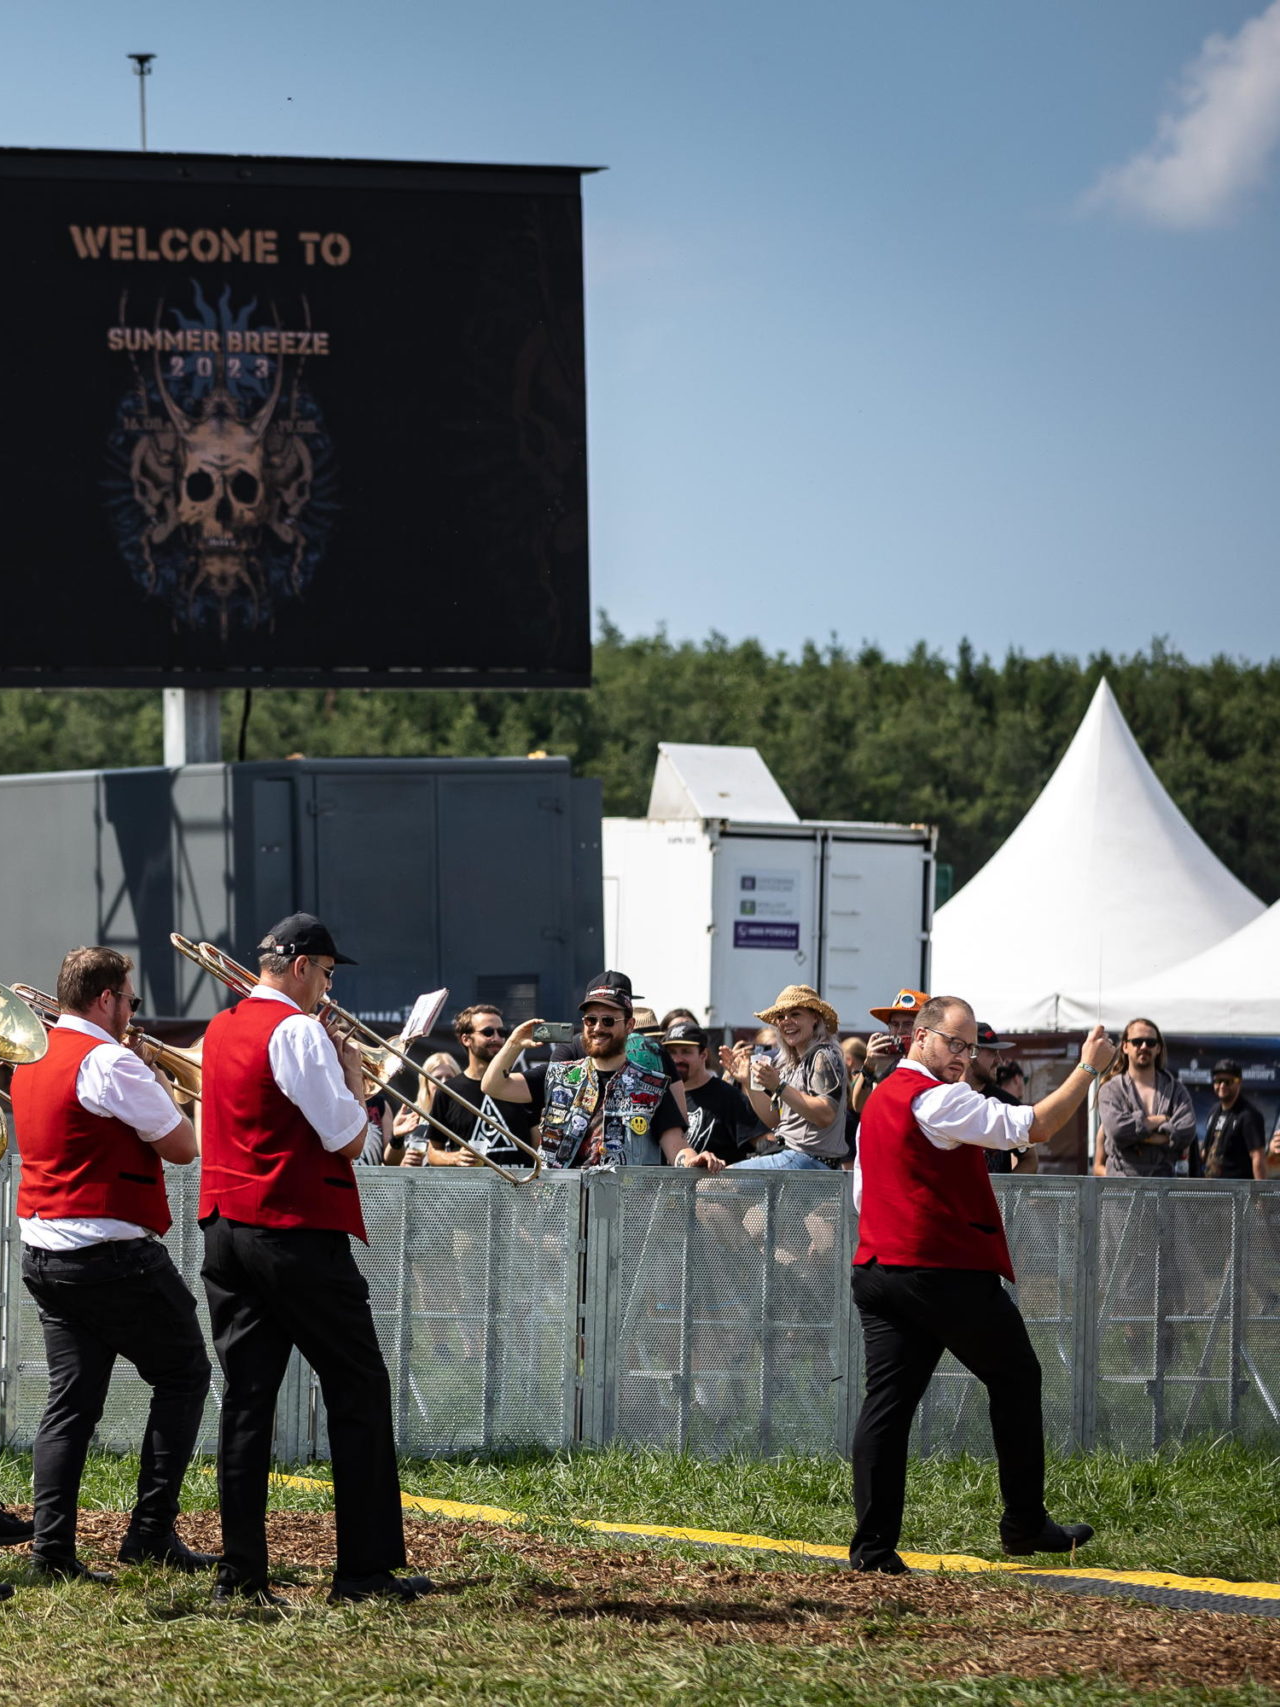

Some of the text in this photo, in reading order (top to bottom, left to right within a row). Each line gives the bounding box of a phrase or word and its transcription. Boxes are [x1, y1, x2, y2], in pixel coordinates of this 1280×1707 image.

[70, 225, 350, 266] WELCOME TO
[107, 328, 330, 355] SUMMER BREEZE
